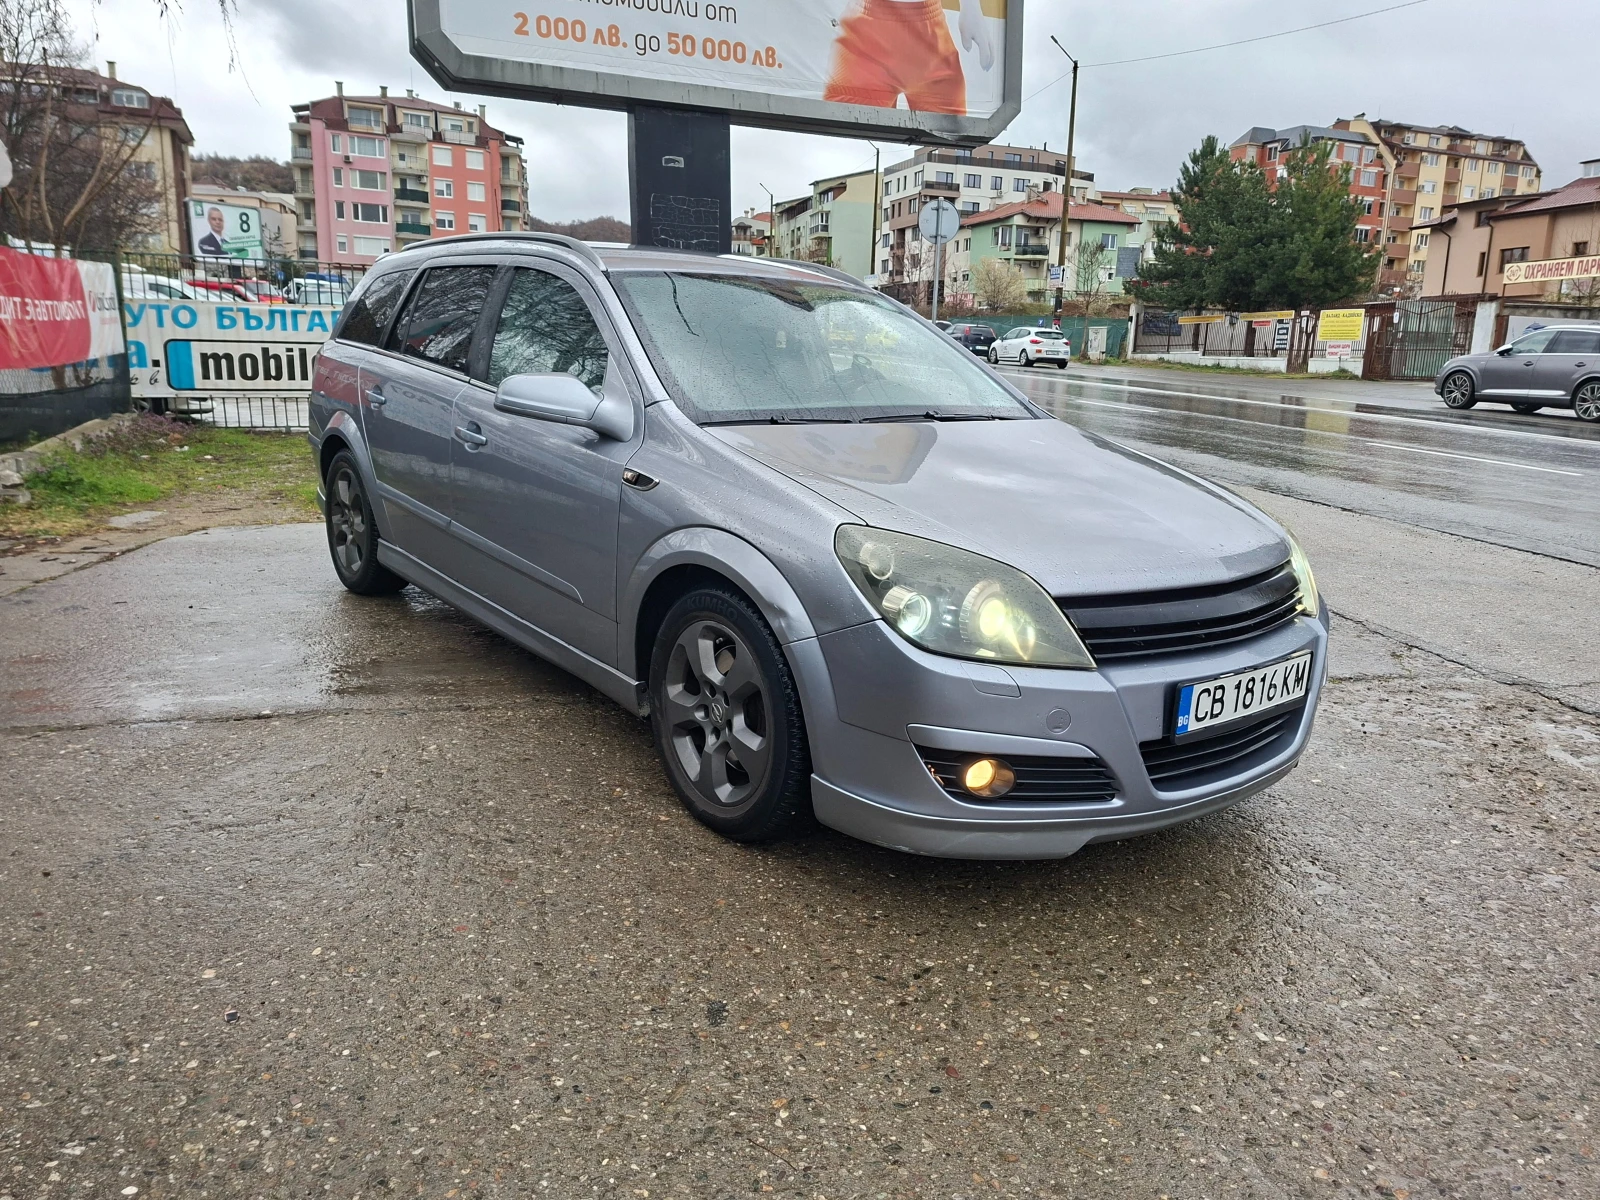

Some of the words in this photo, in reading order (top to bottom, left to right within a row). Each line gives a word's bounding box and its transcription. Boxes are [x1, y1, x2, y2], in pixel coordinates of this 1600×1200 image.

[705, 3, 737, 24] от
[513, 12, 529, 36] 2
[535, 15, 587, 43] 000
[593, 24, 628, 48] лв.
[634, 33, 661, 56] до
[667, 32, 696, 57] 50
[702, 37, 747, 64] 000
[752, 46, 783, 69] лв.
[239, 212, 251, 234] 8
[1524, 261, 1575, 279] ОХРАНЯЕМ
[199, 347, 315, 381] mobil
[1233, 669, 1277, 713] 1816
[1177, 714, 1189, 728] BG
